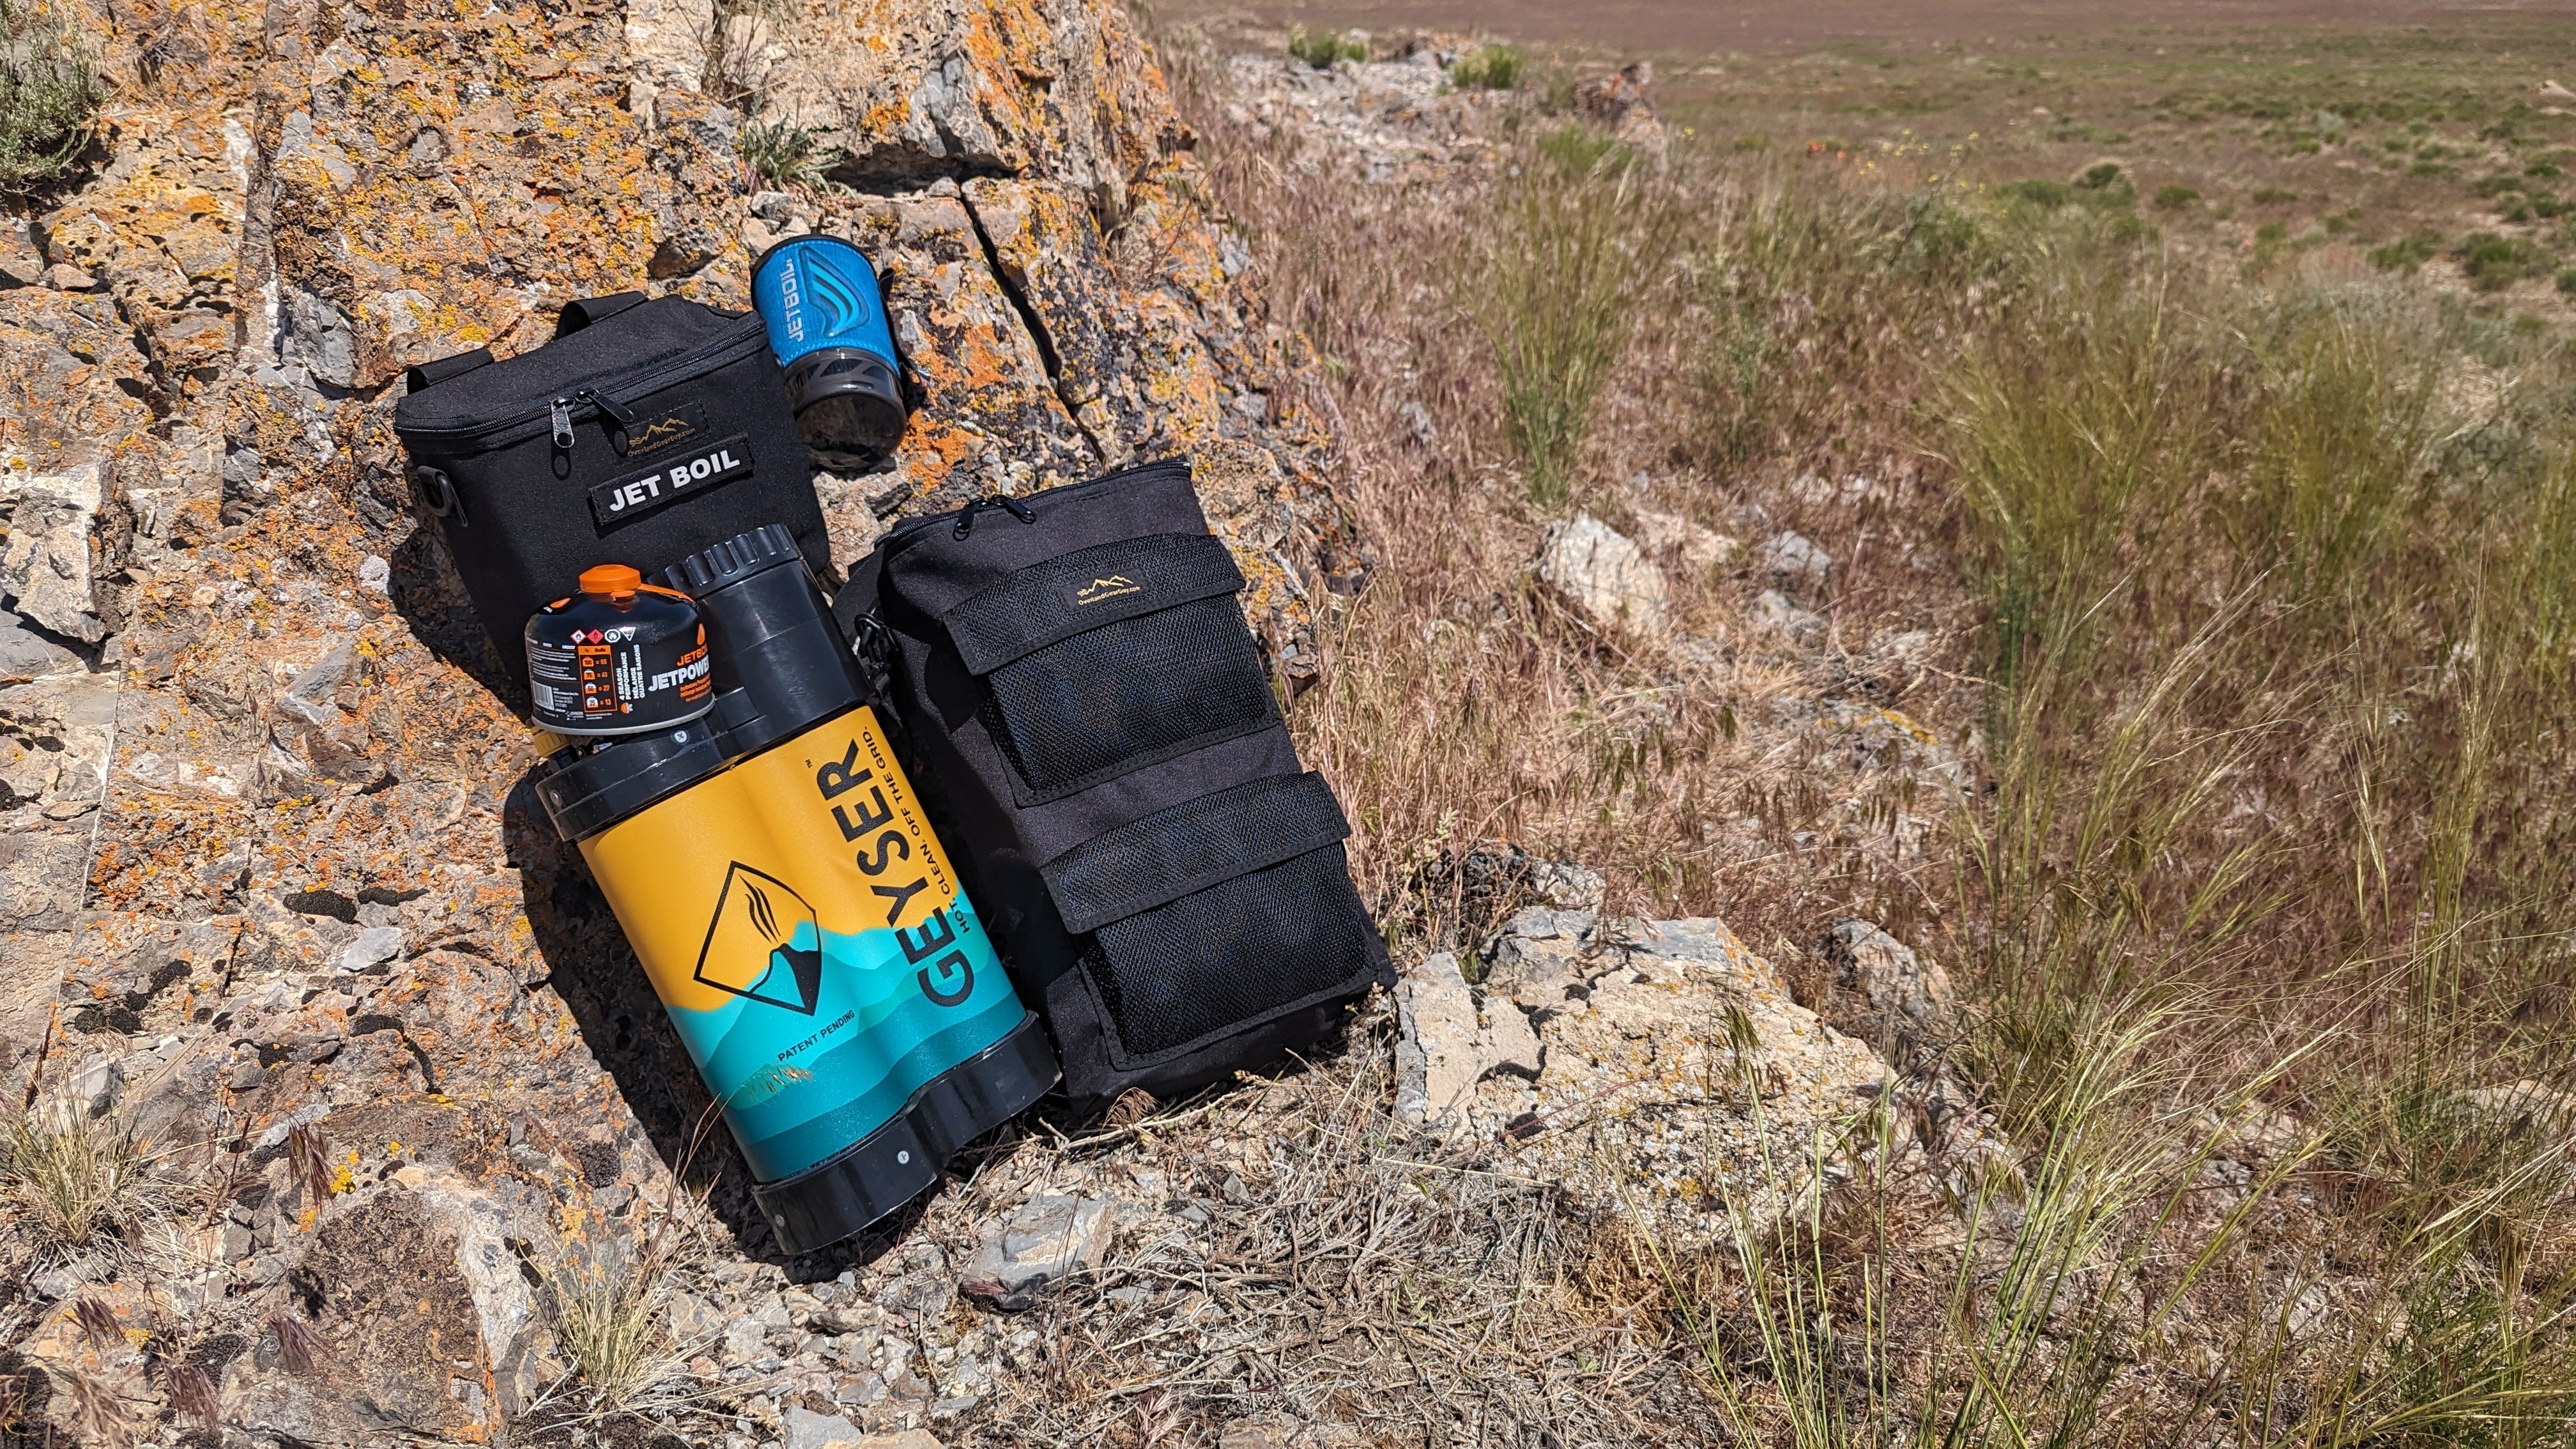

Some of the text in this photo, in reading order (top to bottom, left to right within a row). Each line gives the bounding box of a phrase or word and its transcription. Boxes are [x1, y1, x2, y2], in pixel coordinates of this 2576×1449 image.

[780, 261, 804, 342] JETBOIL
[627, 427, 696, 457] OverlandGearGuy.com
[610, 449, 740, 511] JET BOIL
[1078, 586, 1140, 606] OverlandGearGuy.com
[616, 668, 624, 694] SEASON
[620, 652, 631, 700] PERFORMANCE
[633, 644, 642, 671] SAISONS
[648, 654, 710, 691] JETPOWE
[862, 726, 970, 934] HOT. CLEAN. OFF THE GRID.
[816, 738, 975, 1007] GEYSER
[778, 1009, 855, 1061] PATENT PENDING
